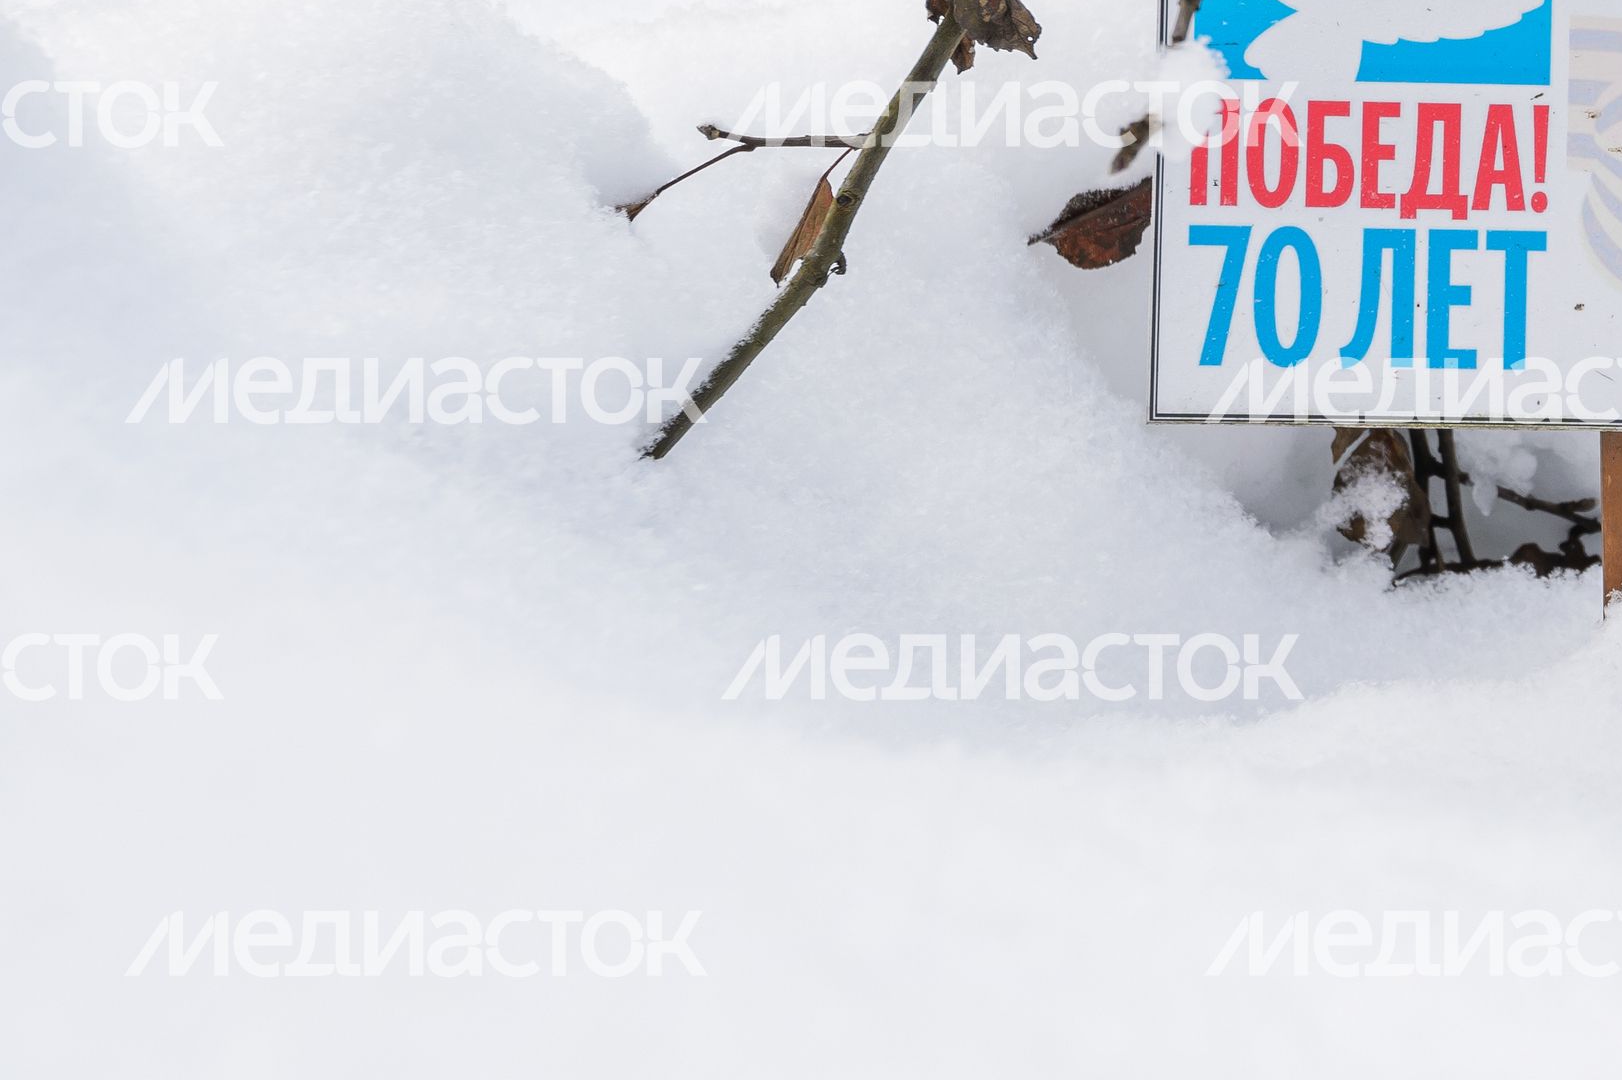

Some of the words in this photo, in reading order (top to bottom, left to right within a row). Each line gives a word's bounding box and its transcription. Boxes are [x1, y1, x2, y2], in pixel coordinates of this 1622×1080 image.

[1188, 97, 1550, 220] ПОБЕДА!
[1188, 224, 1322, 368] 70
[1339, 227, 1547, 370] ЛЕТ
